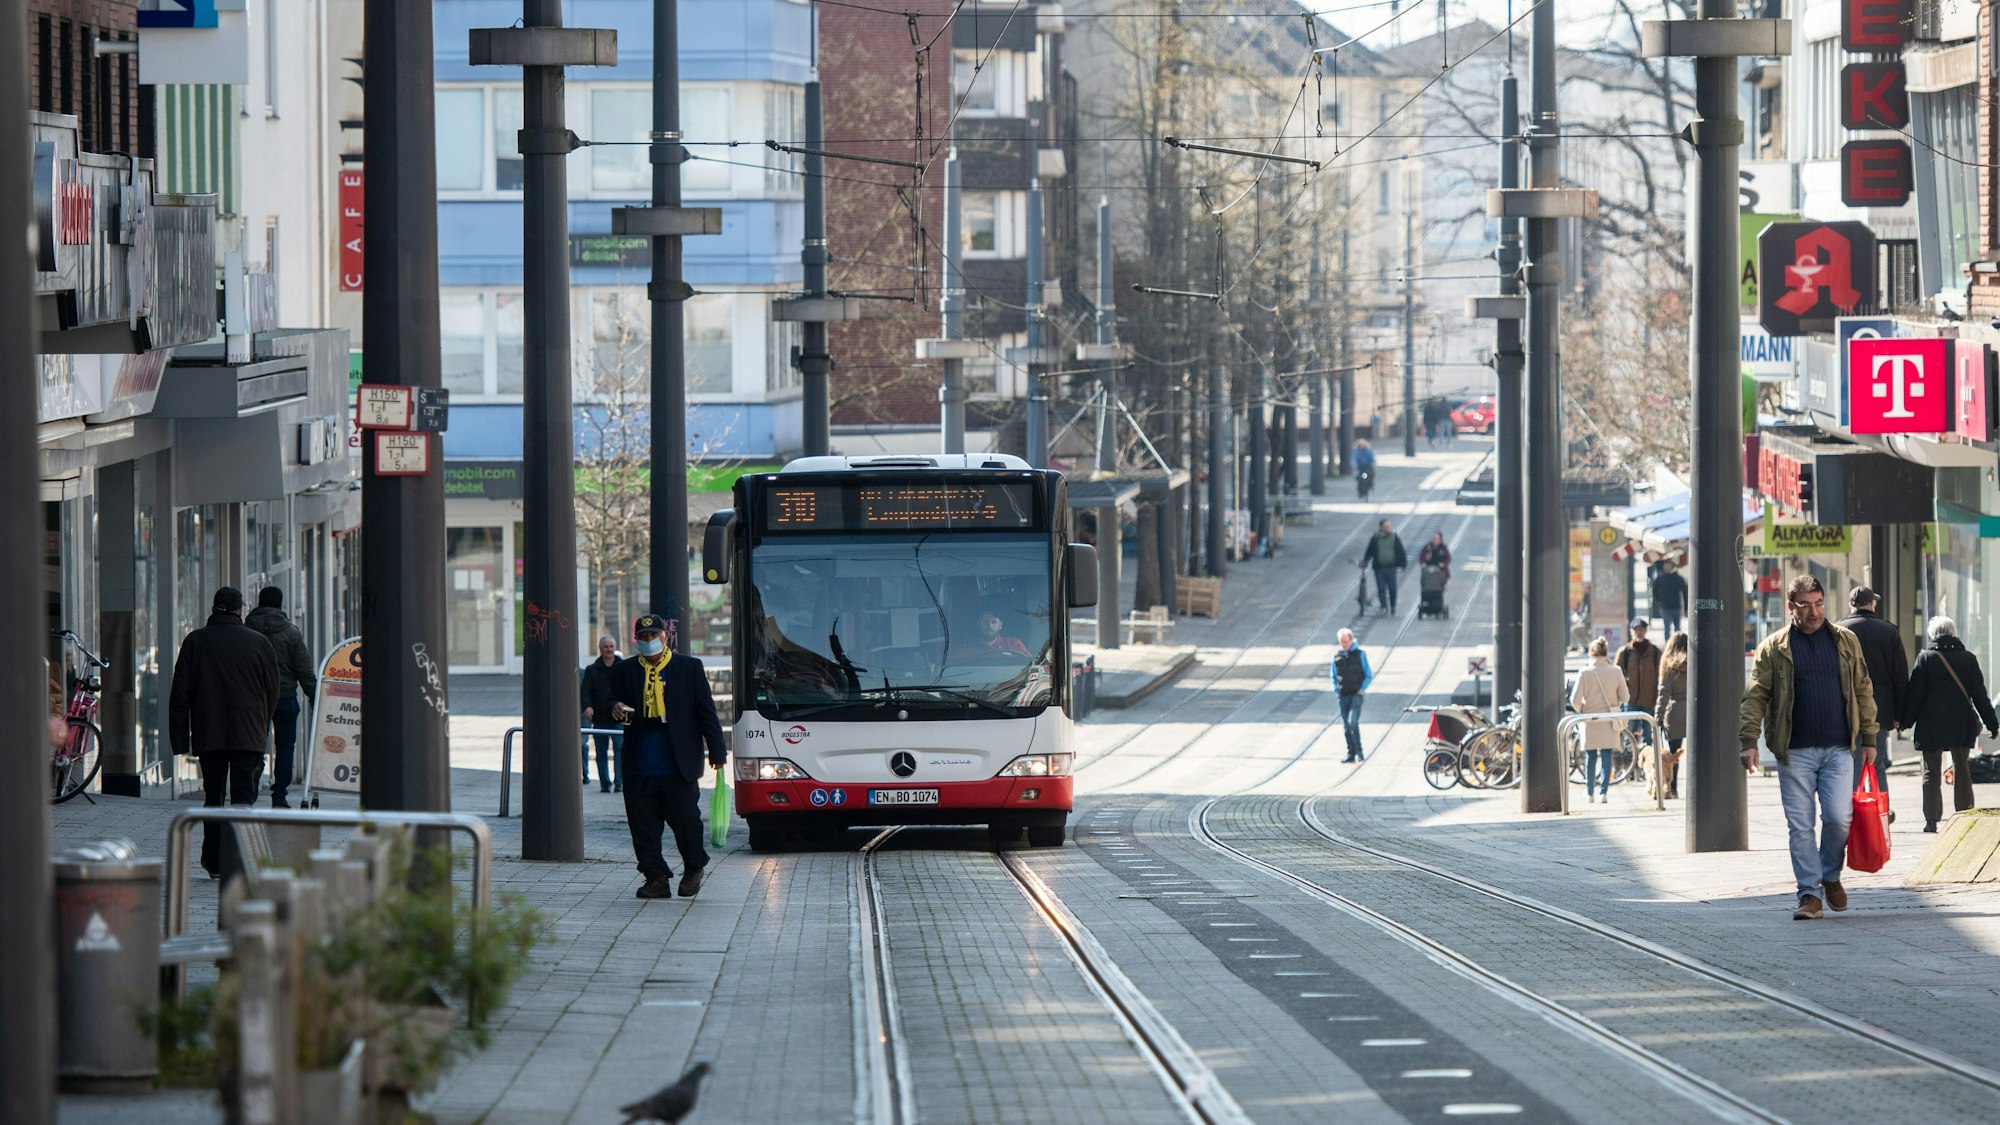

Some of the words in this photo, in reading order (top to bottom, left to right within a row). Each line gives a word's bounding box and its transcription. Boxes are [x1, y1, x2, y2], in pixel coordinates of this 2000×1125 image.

[344, 176, 362, 287] CAFE
[371, 389, 398, 400] H150
[389, 436, 416, 446] H150
[444, 467, 516, 480] mobil.com
[340, 702, 362, 713] Mo
[745, 730, 765, 739] 1074
[876, 790, 889, 803] EN
[896, 790, 910, 803] BO
[912, 789, 938, 803] 1074
